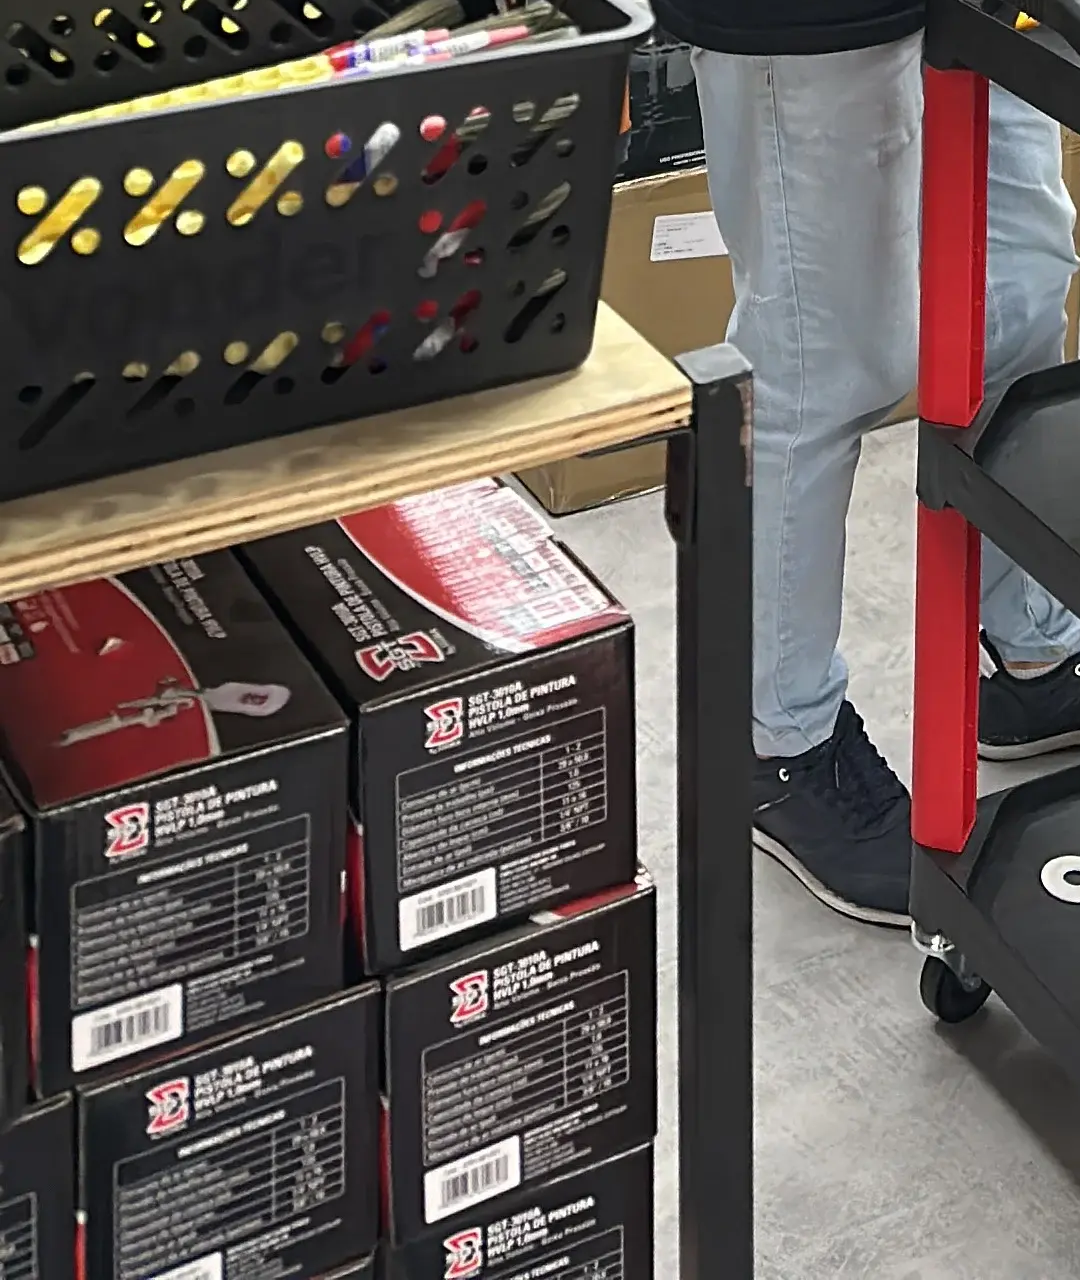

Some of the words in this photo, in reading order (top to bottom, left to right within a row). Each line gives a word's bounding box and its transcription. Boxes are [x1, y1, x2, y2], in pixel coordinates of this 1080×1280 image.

[468, 695, 512, 719] PISTOLA
[514, 691, 528, 704] DE
[530, 674, 577, 699] PINTURA
[468, 712, 496, 730] HVLP
[538, 958, 552, 972] DE
[553, 940, 600, 966] PINTURA
[548, 1195, 596, 1223] PINTURA
